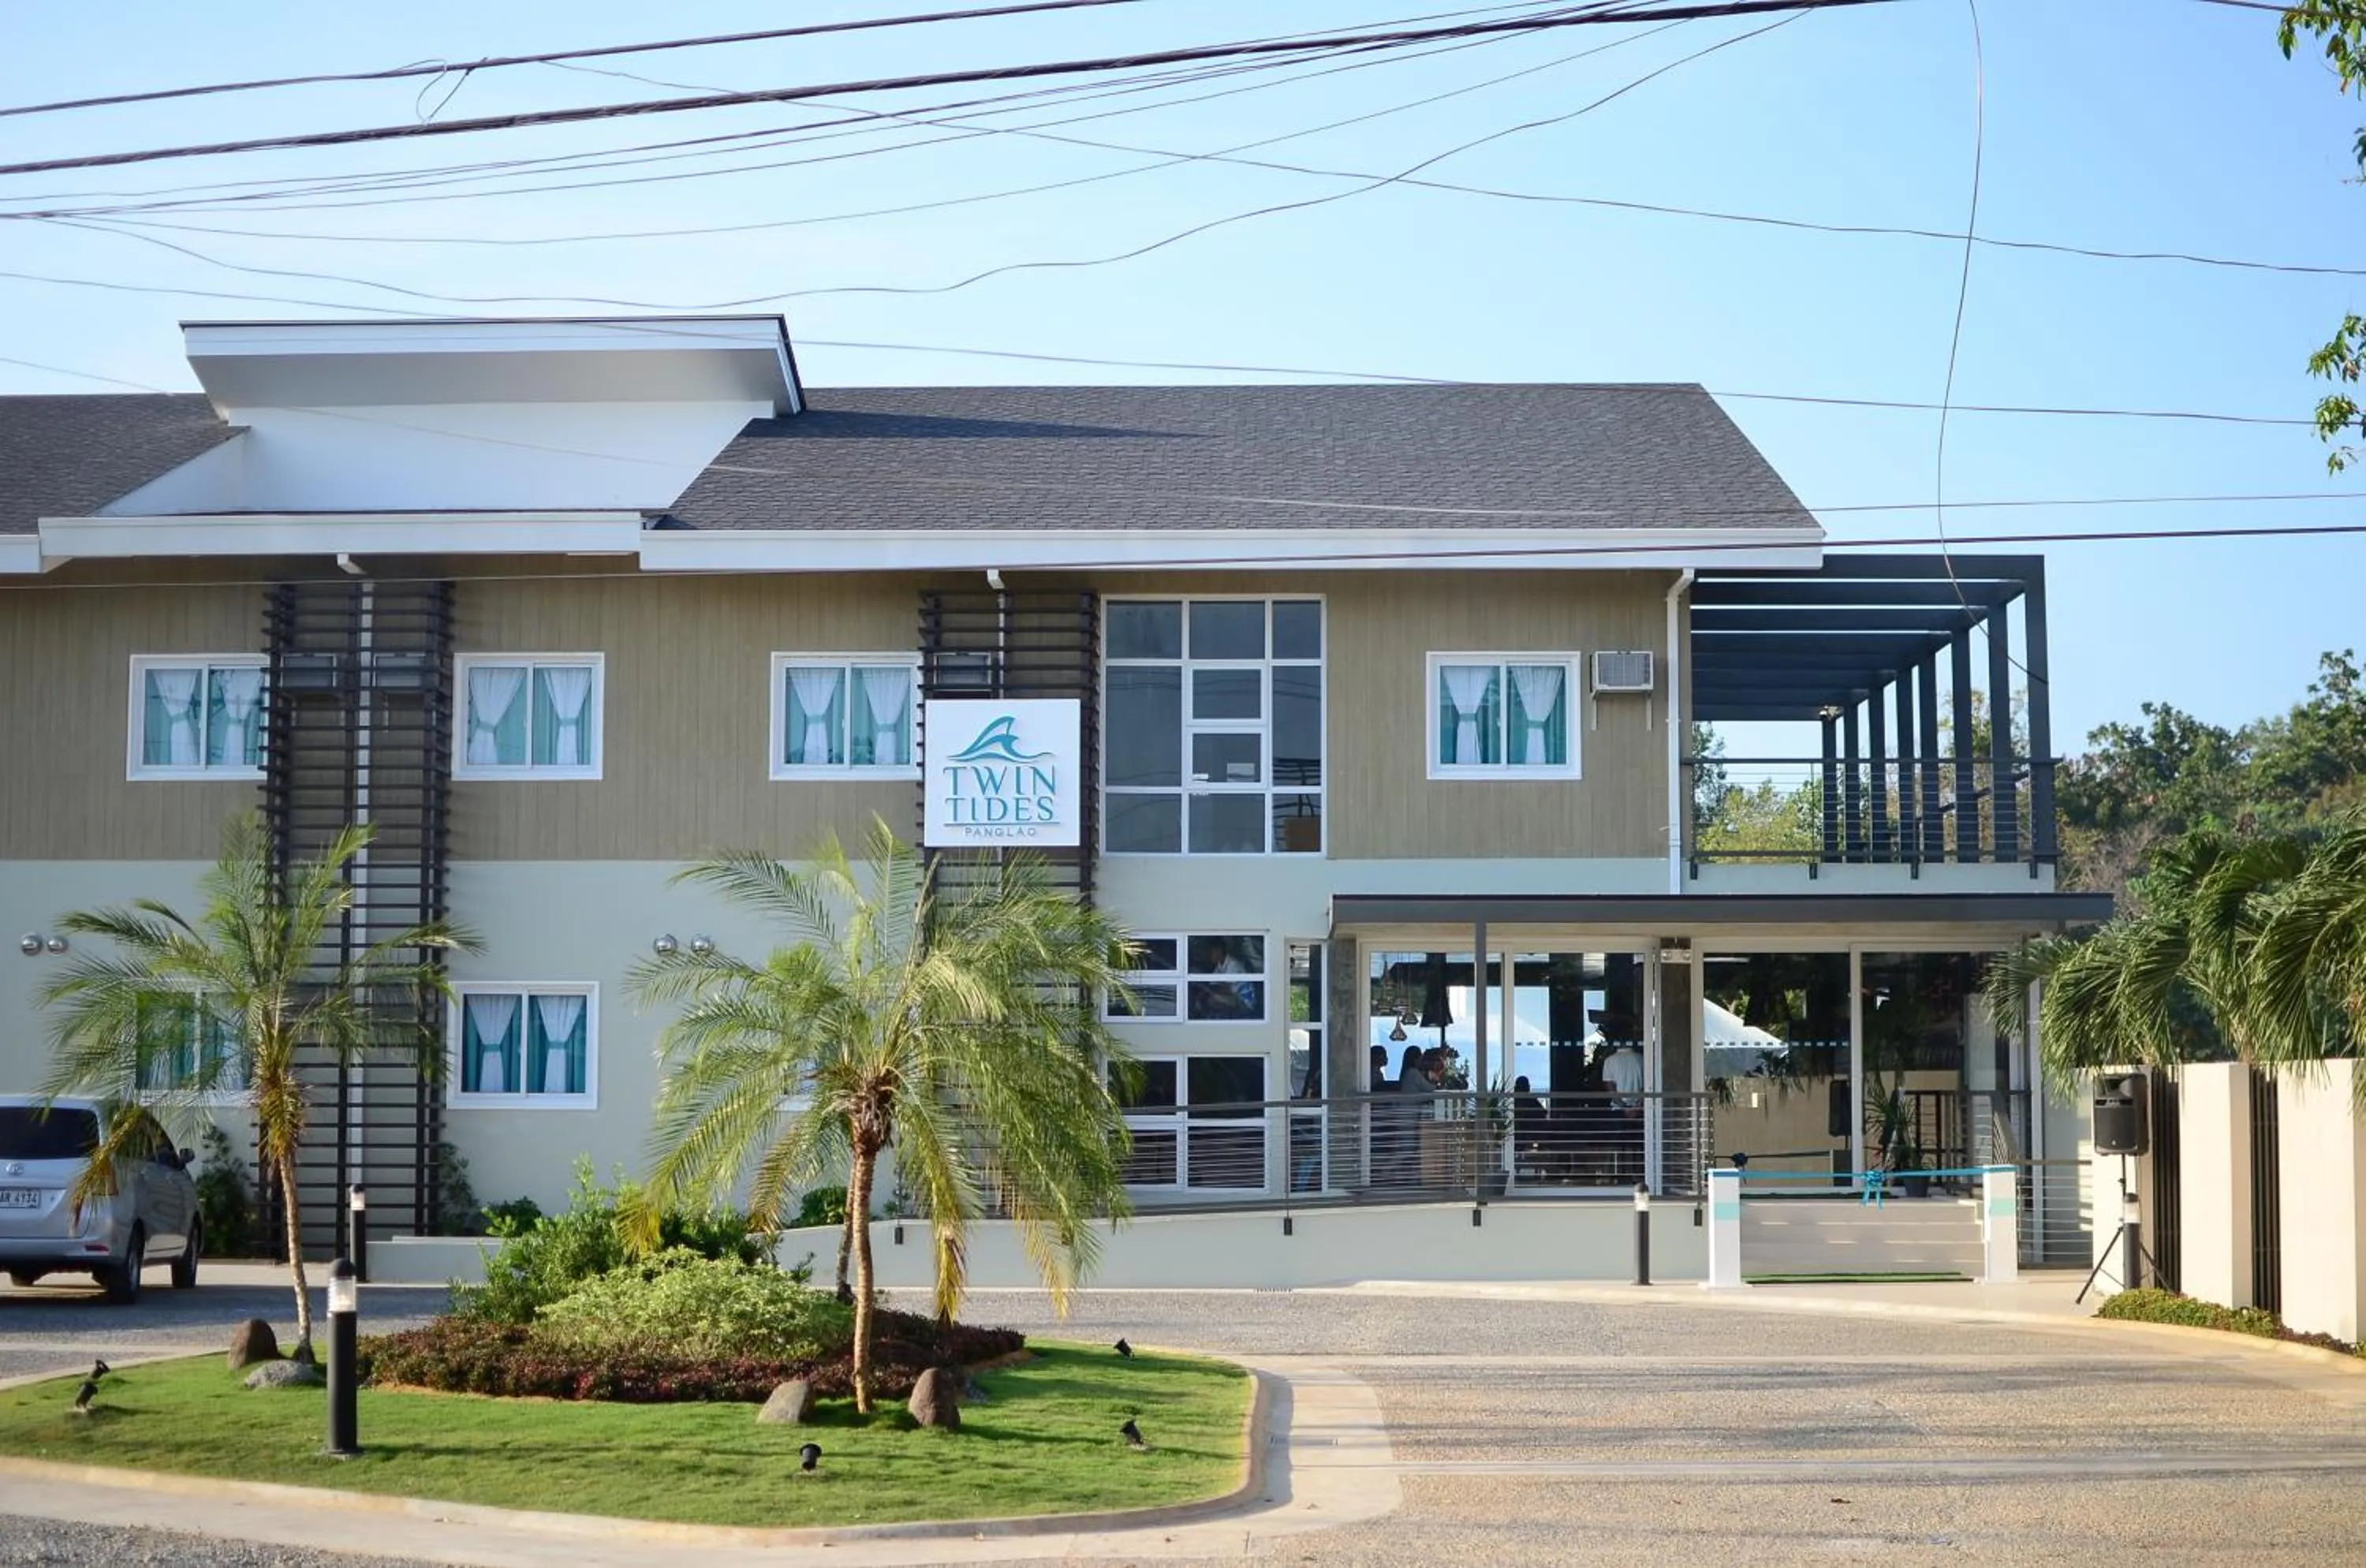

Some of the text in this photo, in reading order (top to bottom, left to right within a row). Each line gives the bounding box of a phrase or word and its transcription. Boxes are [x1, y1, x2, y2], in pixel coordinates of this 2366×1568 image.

[943, 765, 1056, 795] TWIN
[945, 797, 1054, 821] TIDES
[965, 827, 1036, 837] PANGLAO
